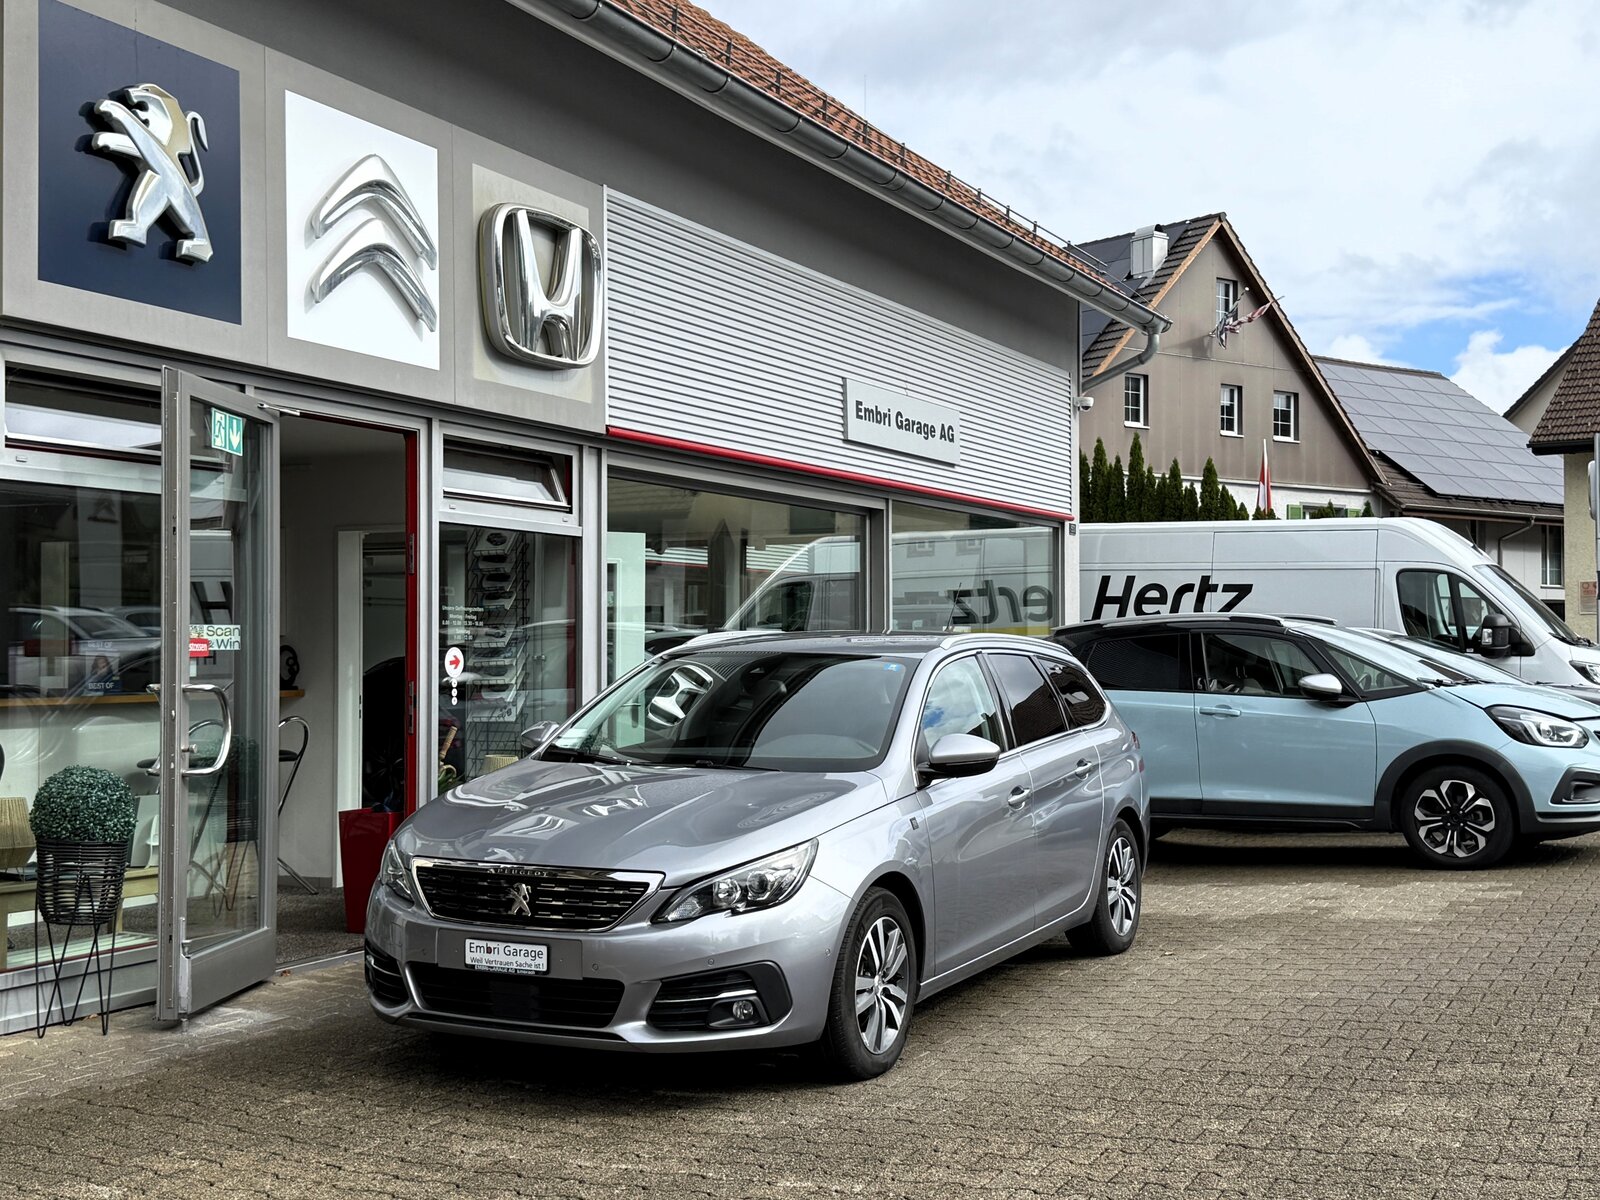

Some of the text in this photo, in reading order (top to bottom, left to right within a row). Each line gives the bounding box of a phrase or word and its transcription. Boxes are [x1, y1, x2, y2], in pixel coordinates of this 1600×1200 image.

[855, 400, 955, 443] Embri Garage AG
[1089, 575, 1253, 620] Hertz
[206, 625, 241, 637] Scan
[216, 637, 241, 649] Win
[497, 868, 549, 878] PEUGEOT
[469, 942, 544, 961] Embri Garage
[469, 956, 484, 964] Weil
[484, 958, 514, 967] Vertrauen
[515, 960, 533, 968] Sache
